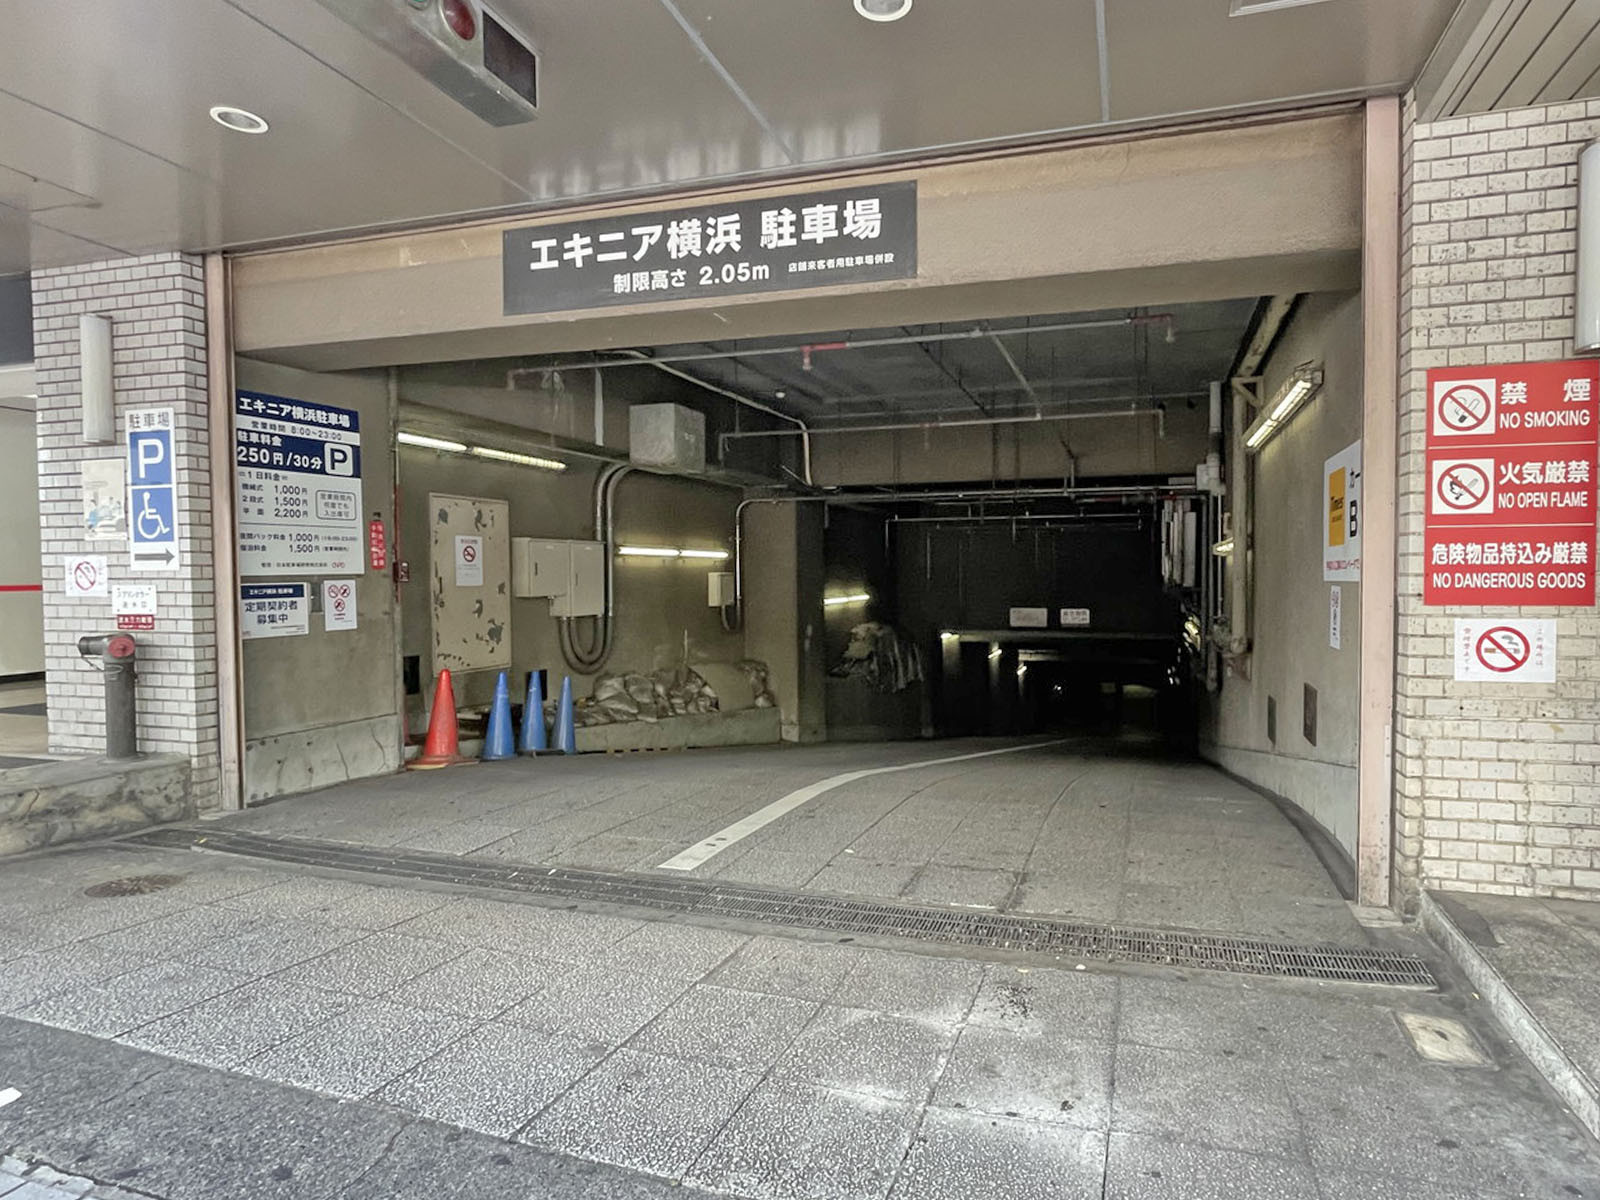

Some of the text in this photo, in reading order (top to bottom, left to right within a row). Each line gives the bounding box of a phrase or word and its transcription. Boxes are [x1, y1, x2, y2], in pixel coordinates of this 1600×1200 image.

[529, 197, 883, 271] エキニア横浜 駐車場
[612, 265, 770, 295] 制限高さ 2.05m
[128, 411, 169, 429] 駐車場
[239, 397, 351, 428] エキニア横浜駐車場
[1500, 409, 1591, 429] NO SMOKING
[251, 420, 286, 433] 営業時間
[237, 430, 282, 447] 駐車料金
[138, 438, 164, 479] P
[330, 447, 348, 471] P
[1499, 459, 1590, 486] 火気厳禁
[1498, 491, 1588, 509] NO OPEN FLAME
[1431, 541, 1589, 566] 危険物品持込み厳禁
[1433, 571, 1586, 588] NO DANGEROUS GOODS
[244, 600, 298, 613] 定期契約者
[257, 613, 288, 625] 募集中
